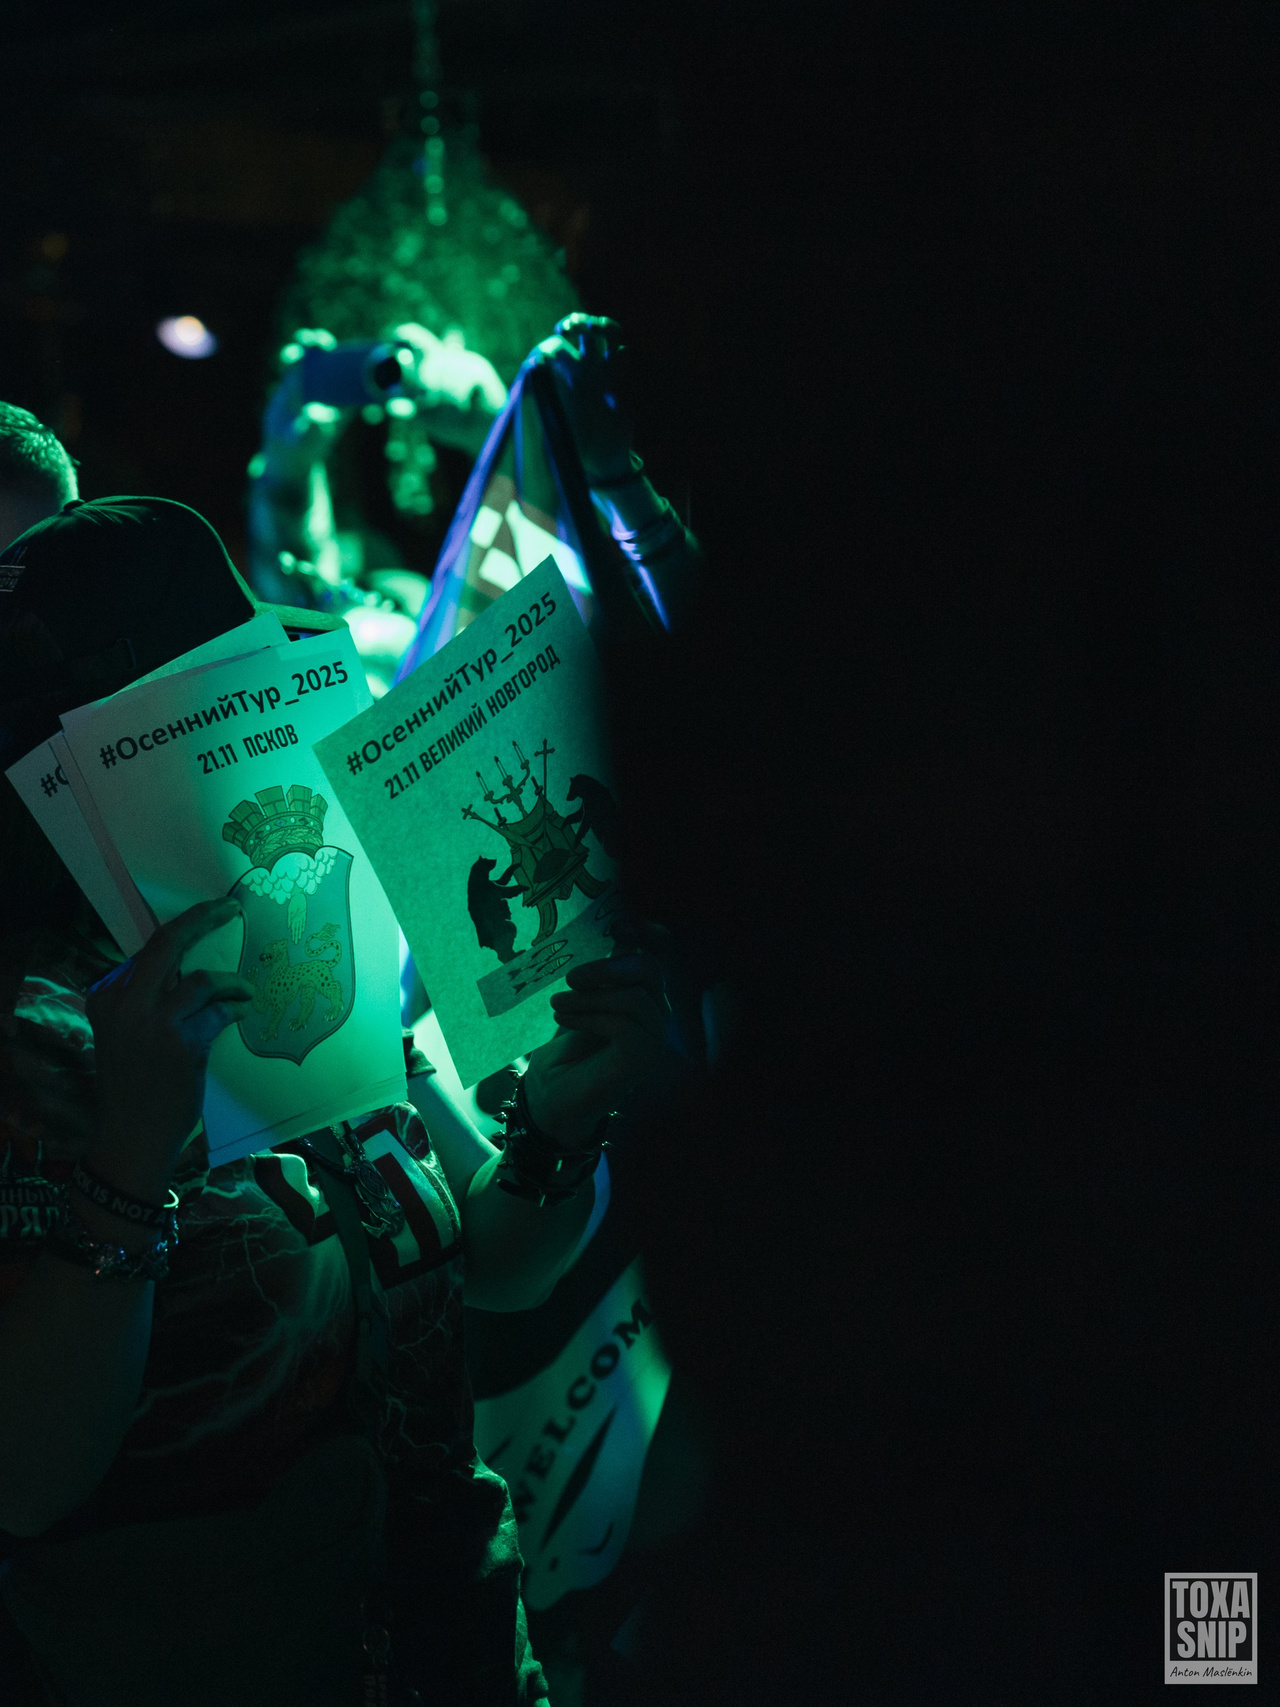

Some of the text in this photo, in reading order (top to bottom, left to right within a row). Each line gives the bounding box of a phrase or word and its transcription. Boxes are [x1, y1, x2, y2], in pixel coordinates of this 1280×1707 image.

[99, 661, 349, 770] #ОсеннийТур_2025
[346, 592, 557, 775] #ОсеннийТур_2025
[384, 644, 562, 800] 21.11 ВЕЛИКИЙ НОВГОРОД
[197, 723, 299, 775] 21.11 ПСКОВ
[111, 1196, 155, 1222] NOT
